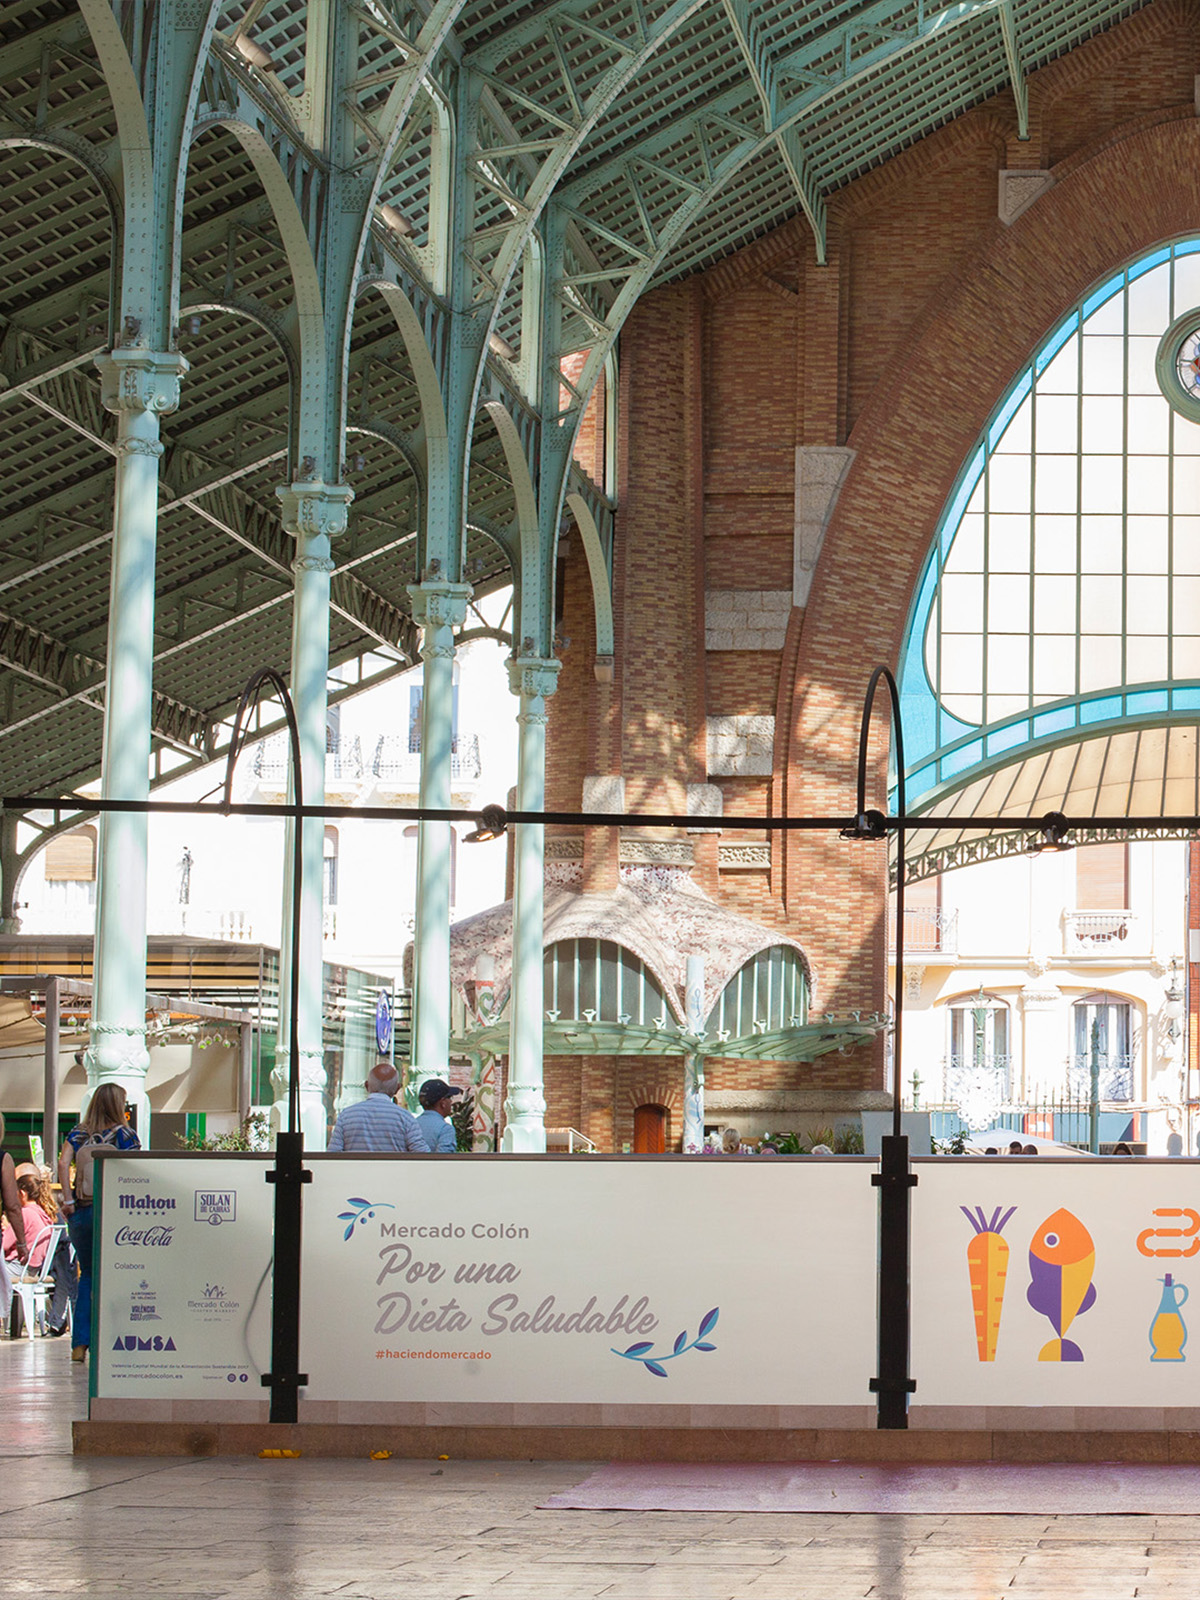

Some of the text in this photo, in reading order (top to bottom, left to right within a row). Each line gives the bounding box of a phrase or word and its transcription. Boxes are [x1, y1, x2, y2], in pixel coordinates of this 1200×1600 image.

[119, 1194, 176, 1209] Mahou
[200, 1194, 230, 1206] SOLAN
[380, 1223, 529, 1239] Mercado Colón
[376, 1243, 521, 1286] Por una
[187, 1300, 240, 1309] Mercado Colón
[373, 1291, 659, 1335] Dieta Saludable
[112, 1335, 177, 1351] AUMSA
[375, 1349, 492, 1360] #haciendomercado
